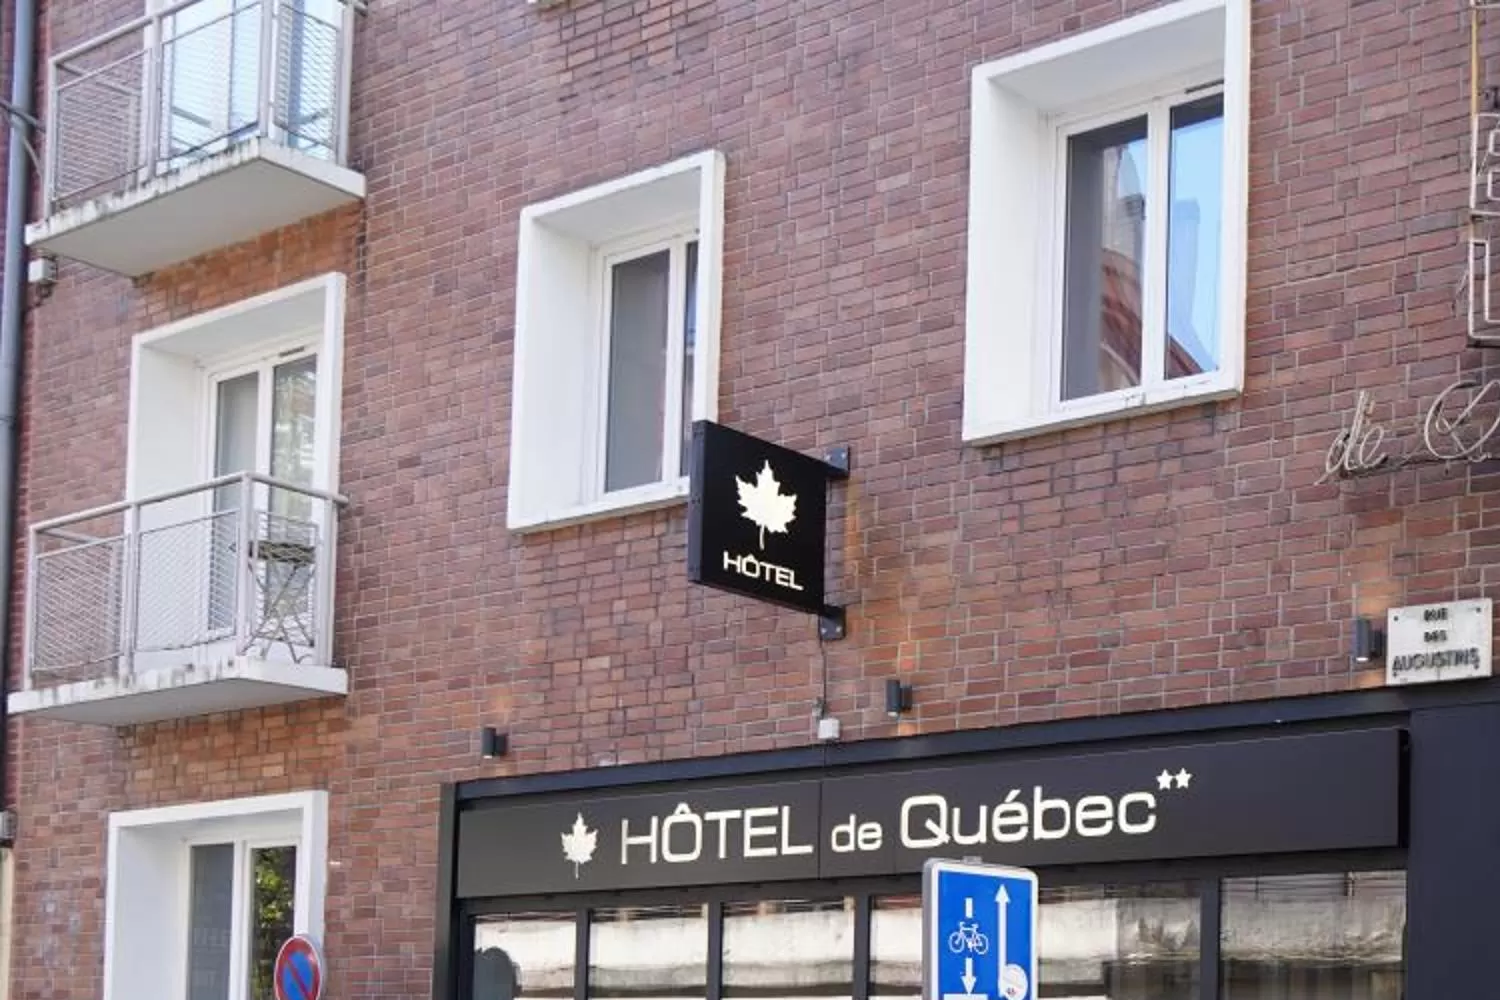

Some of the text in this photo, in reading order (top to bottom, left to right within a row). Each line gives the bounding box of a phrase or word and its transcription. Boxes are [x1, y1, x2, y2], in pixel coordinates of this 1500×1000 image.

[722, 550, 805, 592] HÔTEL
[1423, 608, 1449, 622] RUE
[1423, 629, 1448, 643] DES
[1392, 648, 1481, 672] AUGUSTINS
[619, 785, 1158, 865] HÔTEL de Québec
